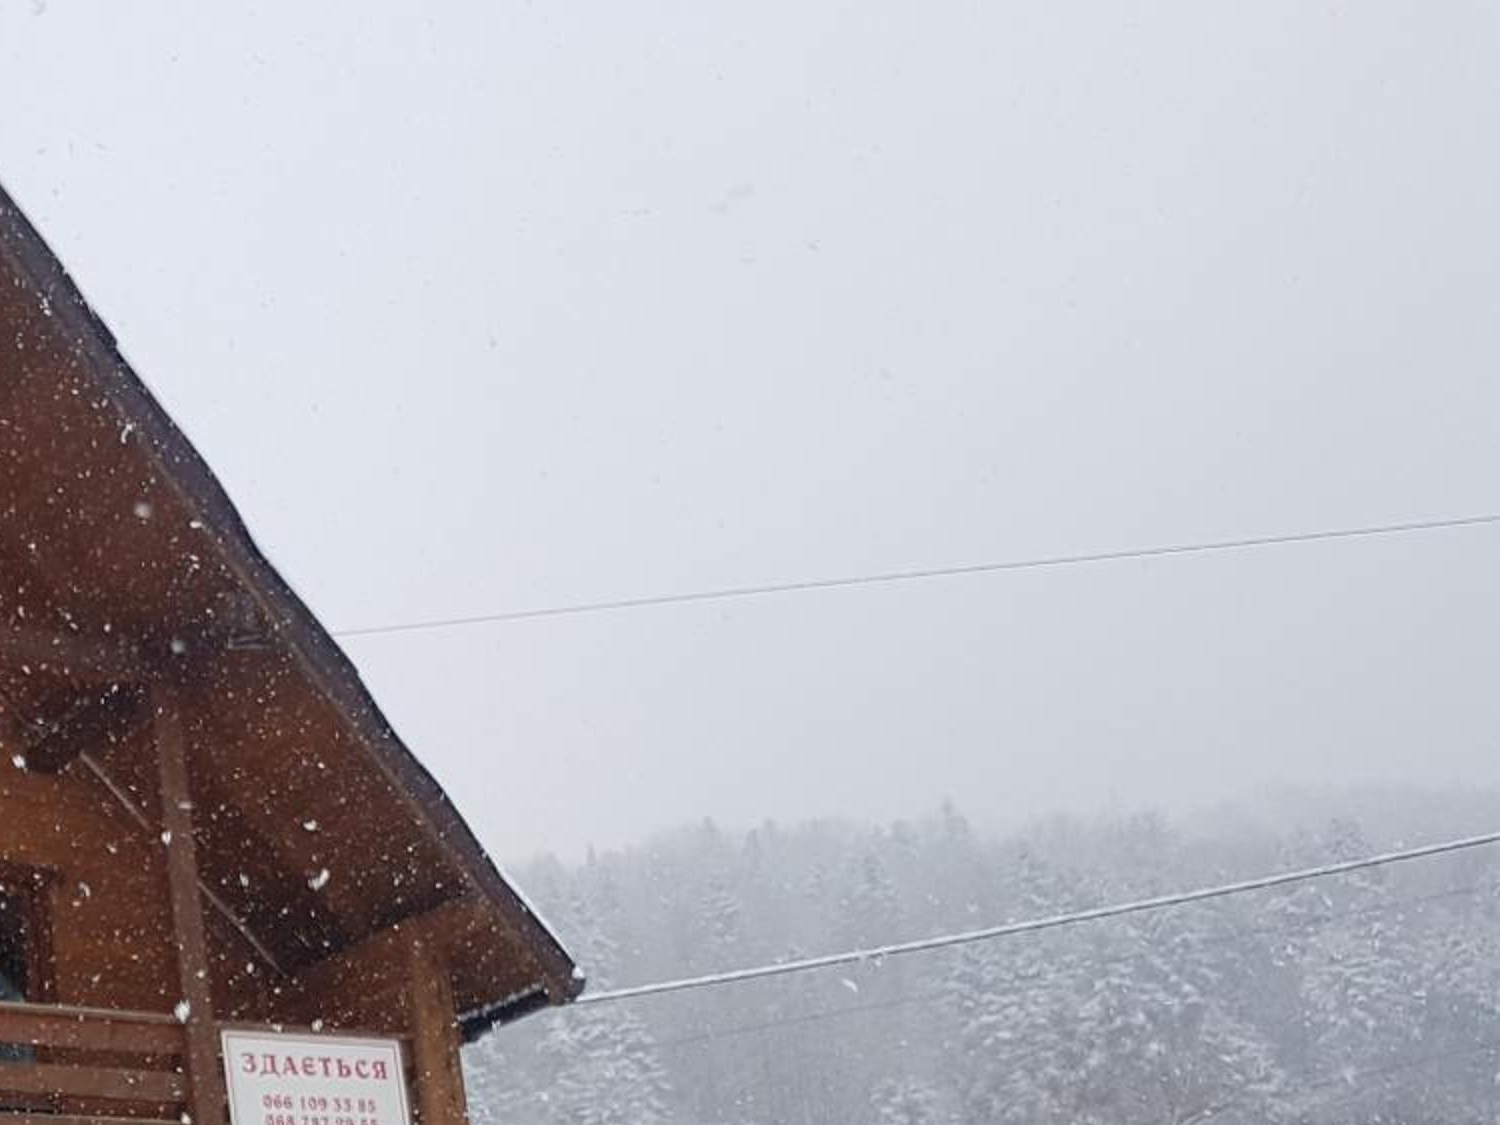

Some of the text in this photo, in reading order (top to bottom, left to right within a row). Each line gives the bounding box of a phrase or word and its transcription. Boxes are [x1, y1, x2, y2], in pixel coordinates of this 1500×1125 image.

[240, 1053, 388, 1080] ЗДАЄТЬСЯ
[262, 1094, 293, 1110] 066
[300, 1096, 328, 1111] 109
